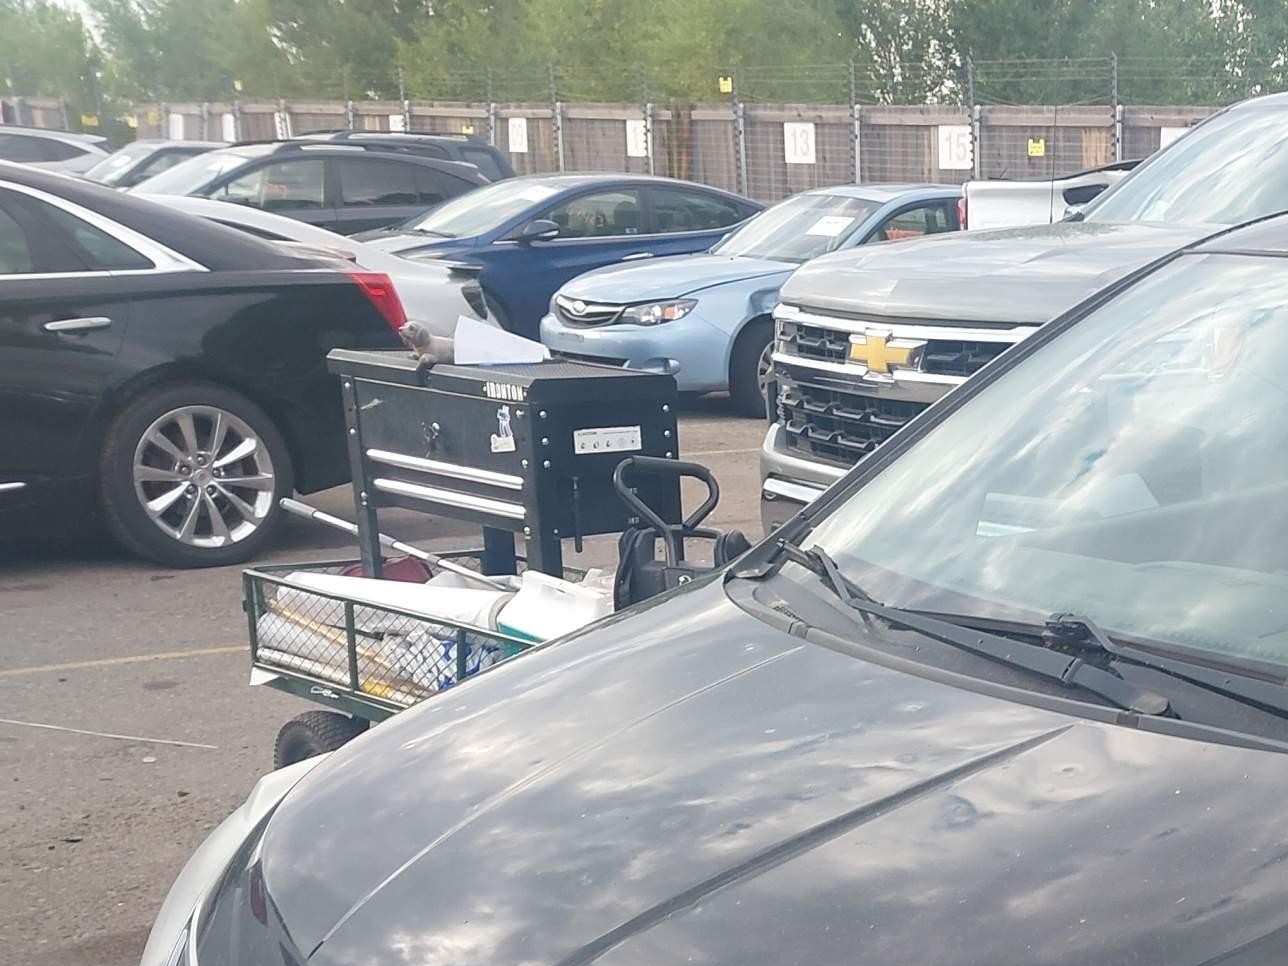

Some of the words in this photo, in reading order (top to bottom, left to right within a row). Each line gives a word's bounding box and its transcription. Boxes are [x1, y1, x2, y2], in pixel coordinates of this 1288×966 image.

[790, 128, 809, 156] 13
[945, 131, 967, 161] 15
[486, 381, 524, 401] IRONTON
